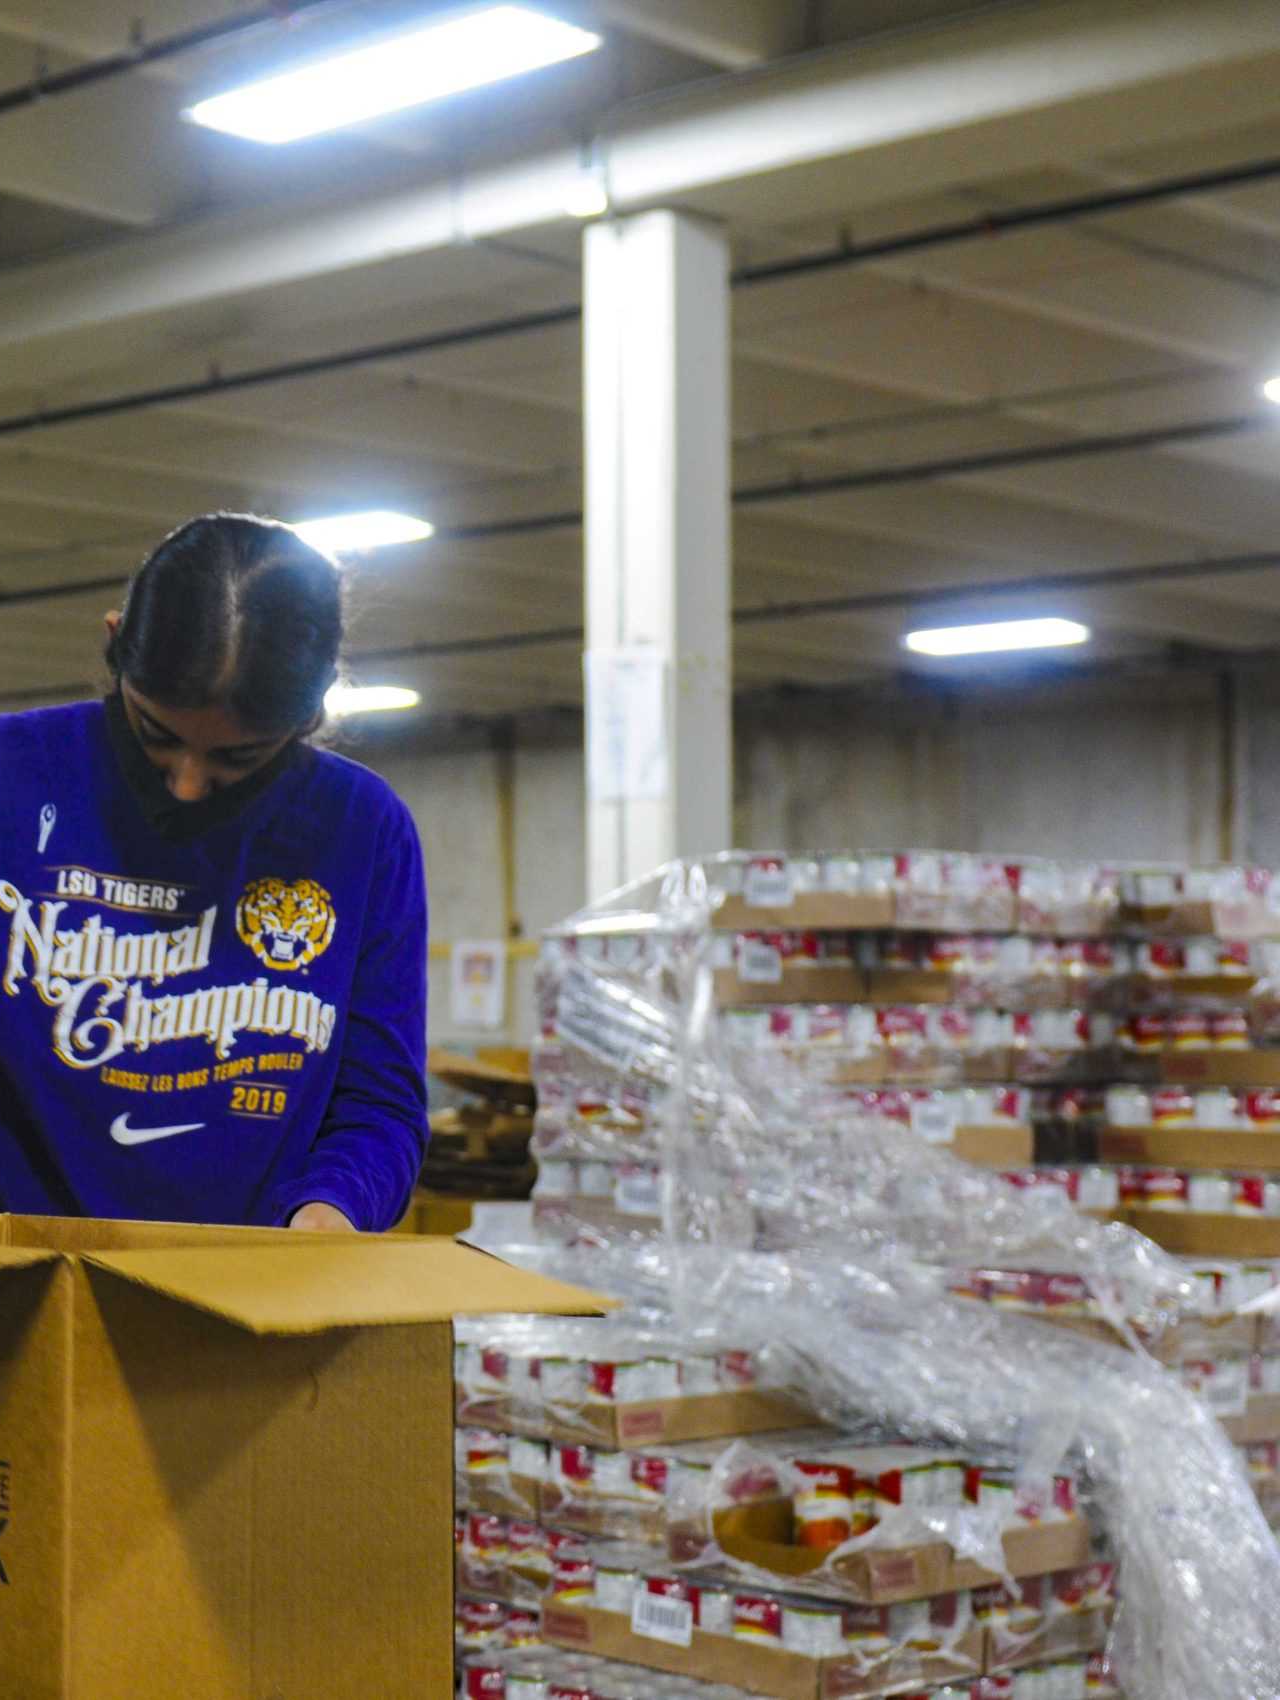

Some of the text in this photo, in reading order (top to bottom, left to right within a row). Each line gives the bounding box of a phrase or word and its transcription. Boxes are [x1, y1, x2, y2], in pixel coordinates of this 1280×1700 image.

[58, 870, 181, 911] LSU TIGERS
[53, 974, 337, 1069] Champions
[152, 1075, 173, 1092] LES
[177, 1069, 209, 1090] BONS
[214, 1057, 255, 1082] TEMPS
[230, 1087, 286, 1114] 2019
